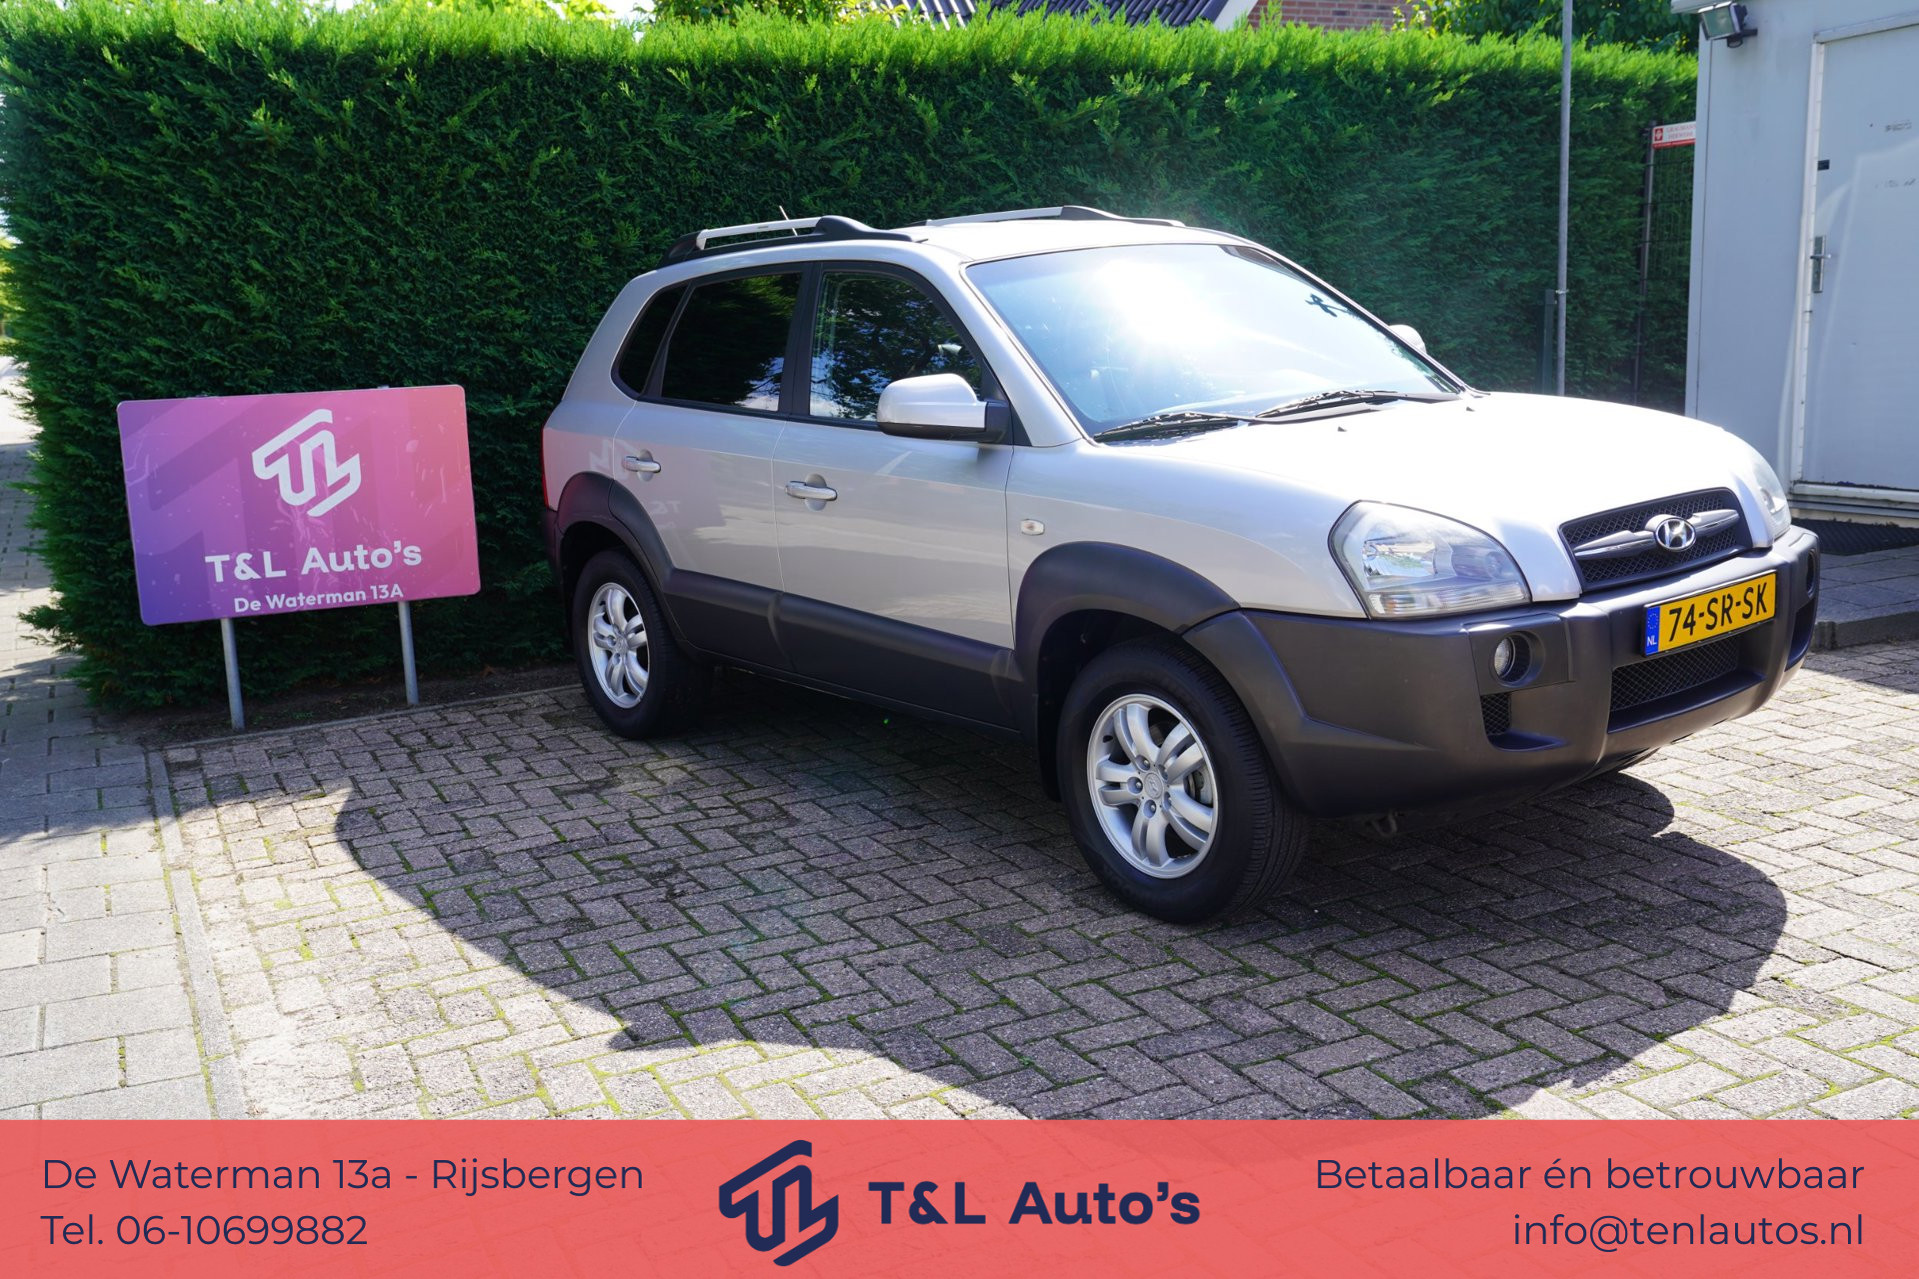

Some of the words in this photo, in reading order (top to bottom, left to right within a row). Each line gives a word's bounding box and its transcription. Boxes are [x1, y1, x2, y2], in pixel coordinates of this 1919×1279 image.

[204, 550, 287, 583] T&L
[301, 539, 423, 576] Auto's
[233, 597, 262, 613] De
[265, 588, 367, 610] Waterman
[370, 583, 404, 600] 13A
[1668, 581, 1768, 643] 74-SR-SK
[1646, 635, 1658, 647] NL
